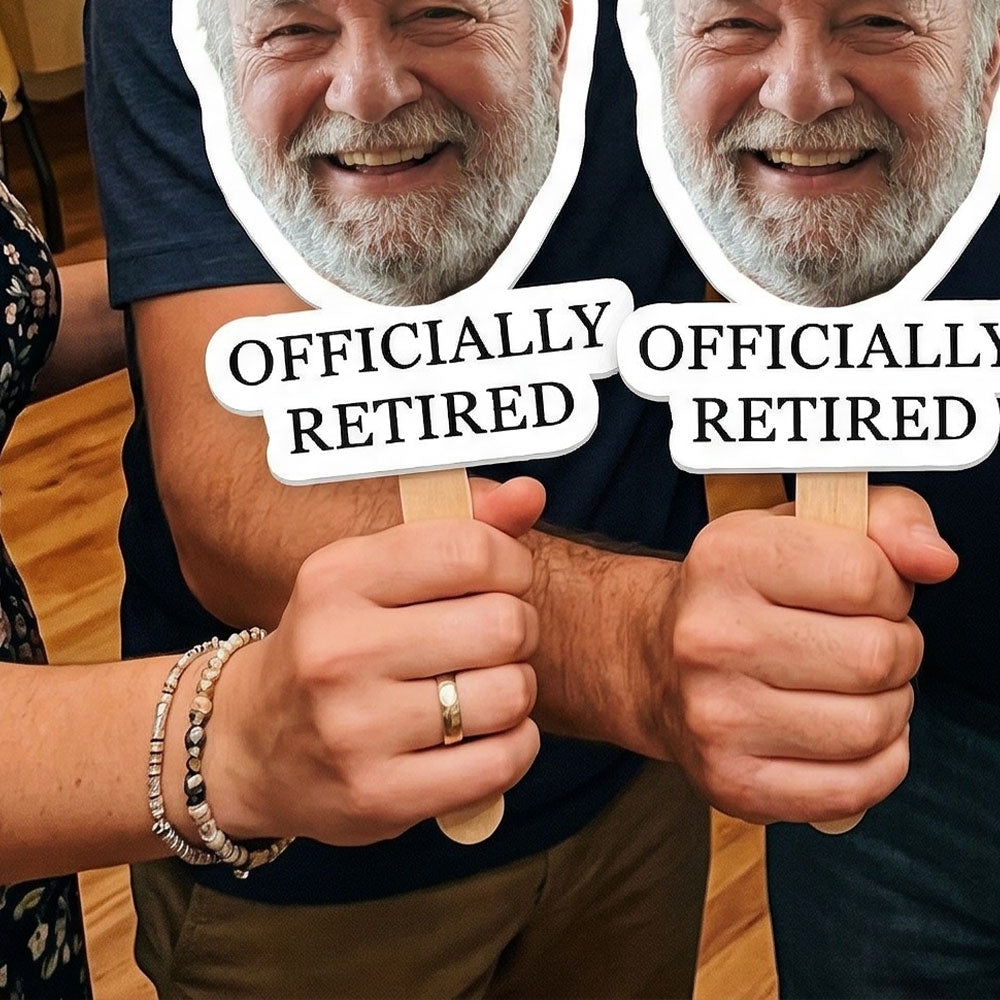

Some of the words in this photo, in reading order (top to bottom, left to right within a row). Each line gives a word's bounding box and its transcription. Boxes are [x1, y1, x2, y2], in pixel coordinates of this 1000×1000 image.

[229, 301, 611, 387] OFFICIALLY
[286, 381, 575, 455] RETIRED
[692, 395, 977, 443] RETIRED
